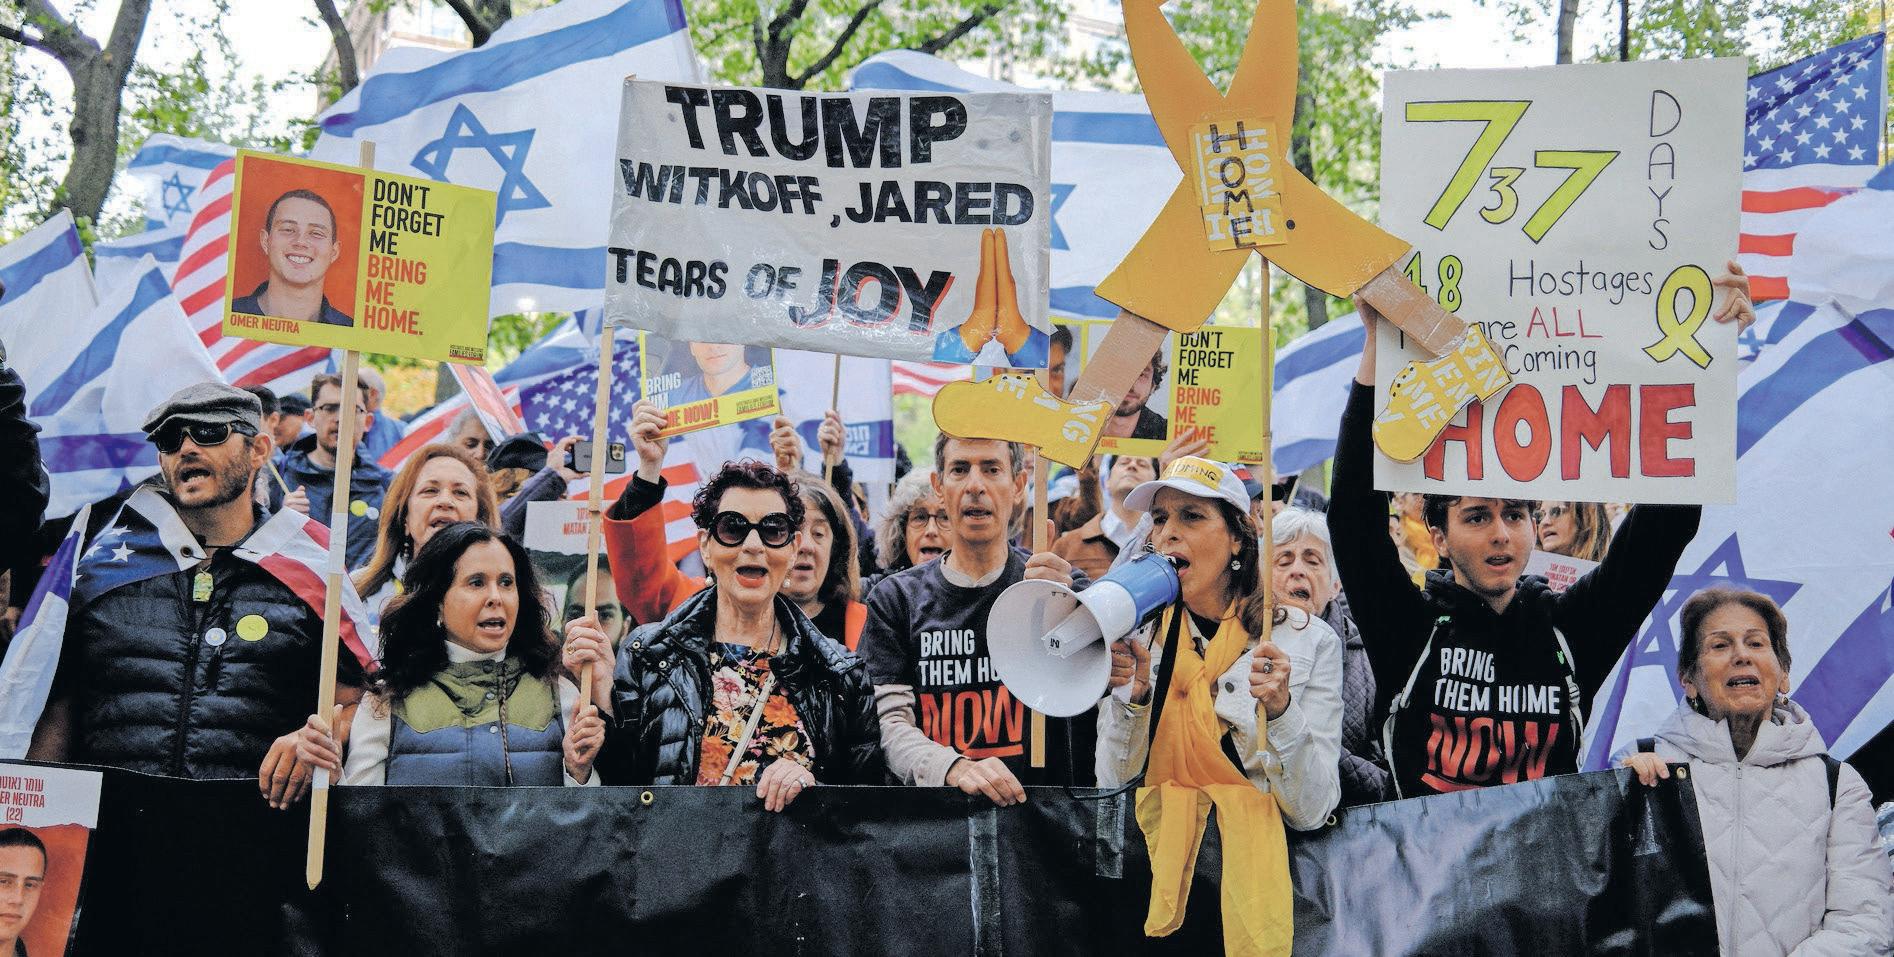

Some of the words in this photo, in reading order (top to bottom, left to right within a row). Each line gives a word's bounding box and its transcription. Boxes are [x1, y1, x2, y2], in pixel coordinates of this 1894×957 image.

[665, 85, 968, 168] TRUMP
[1210, 121, 1257, 249] HOME
[1405, 99, 1621, 245] 737
[1648, 89, 1682, 250] DAYS
[373, 178, 430, 209] DON'T
[619, 158, 823, 214] WITKOFF
[371, 204, 445, 237] FORGET
[369, 229, 399, 255] ME
[367, 253, 427, 285] BRING
[1509, 259, 1654, 305] Hostages
[365, 279, 396, 306] ME
[608, 247, 729, 300] TEARS
[743, 262, 801, 300] OF
[788, 258, 955, 336] JOY
[230, 314, 259, 329] OMER
[261, 317, 300, 334] NEUTRA
[363, 304, 424, 336] HOME.
[1527, 306, 1604, 339] ALL
[1180, 331, 1223, 349] DON'T
[1179, 349, 1234, 369] FORGET
[1504, 343, 1597, 385] Coming
[646, 371, 682, 395] BRING
[1178, 368, 1199, 386] ME
[683, 399, 719, 425] NOW!
[1176, 386, 1221, 406] BRING
[1175, 405, 1197, 424] ME
[1423, 383, 1697, 482] HOME
[1166, 463, 1217, 481] OMING
[920, 628, 975, 658] BRING
[918, 658, 972, 687] THEM
[977, 656, 1001, 683] HO
[1440, 647, 1495, 683] BRING
[1434, 678, 1491, 712] THEM
[1498, 683, 1561, 715] HOME
[919, 684, 1025, 752] NOW
[1427, 712, 1560, 785] NOW
[6, 806, 23, 822] (22)
[12, 792, 45, 808] NEUTRA
